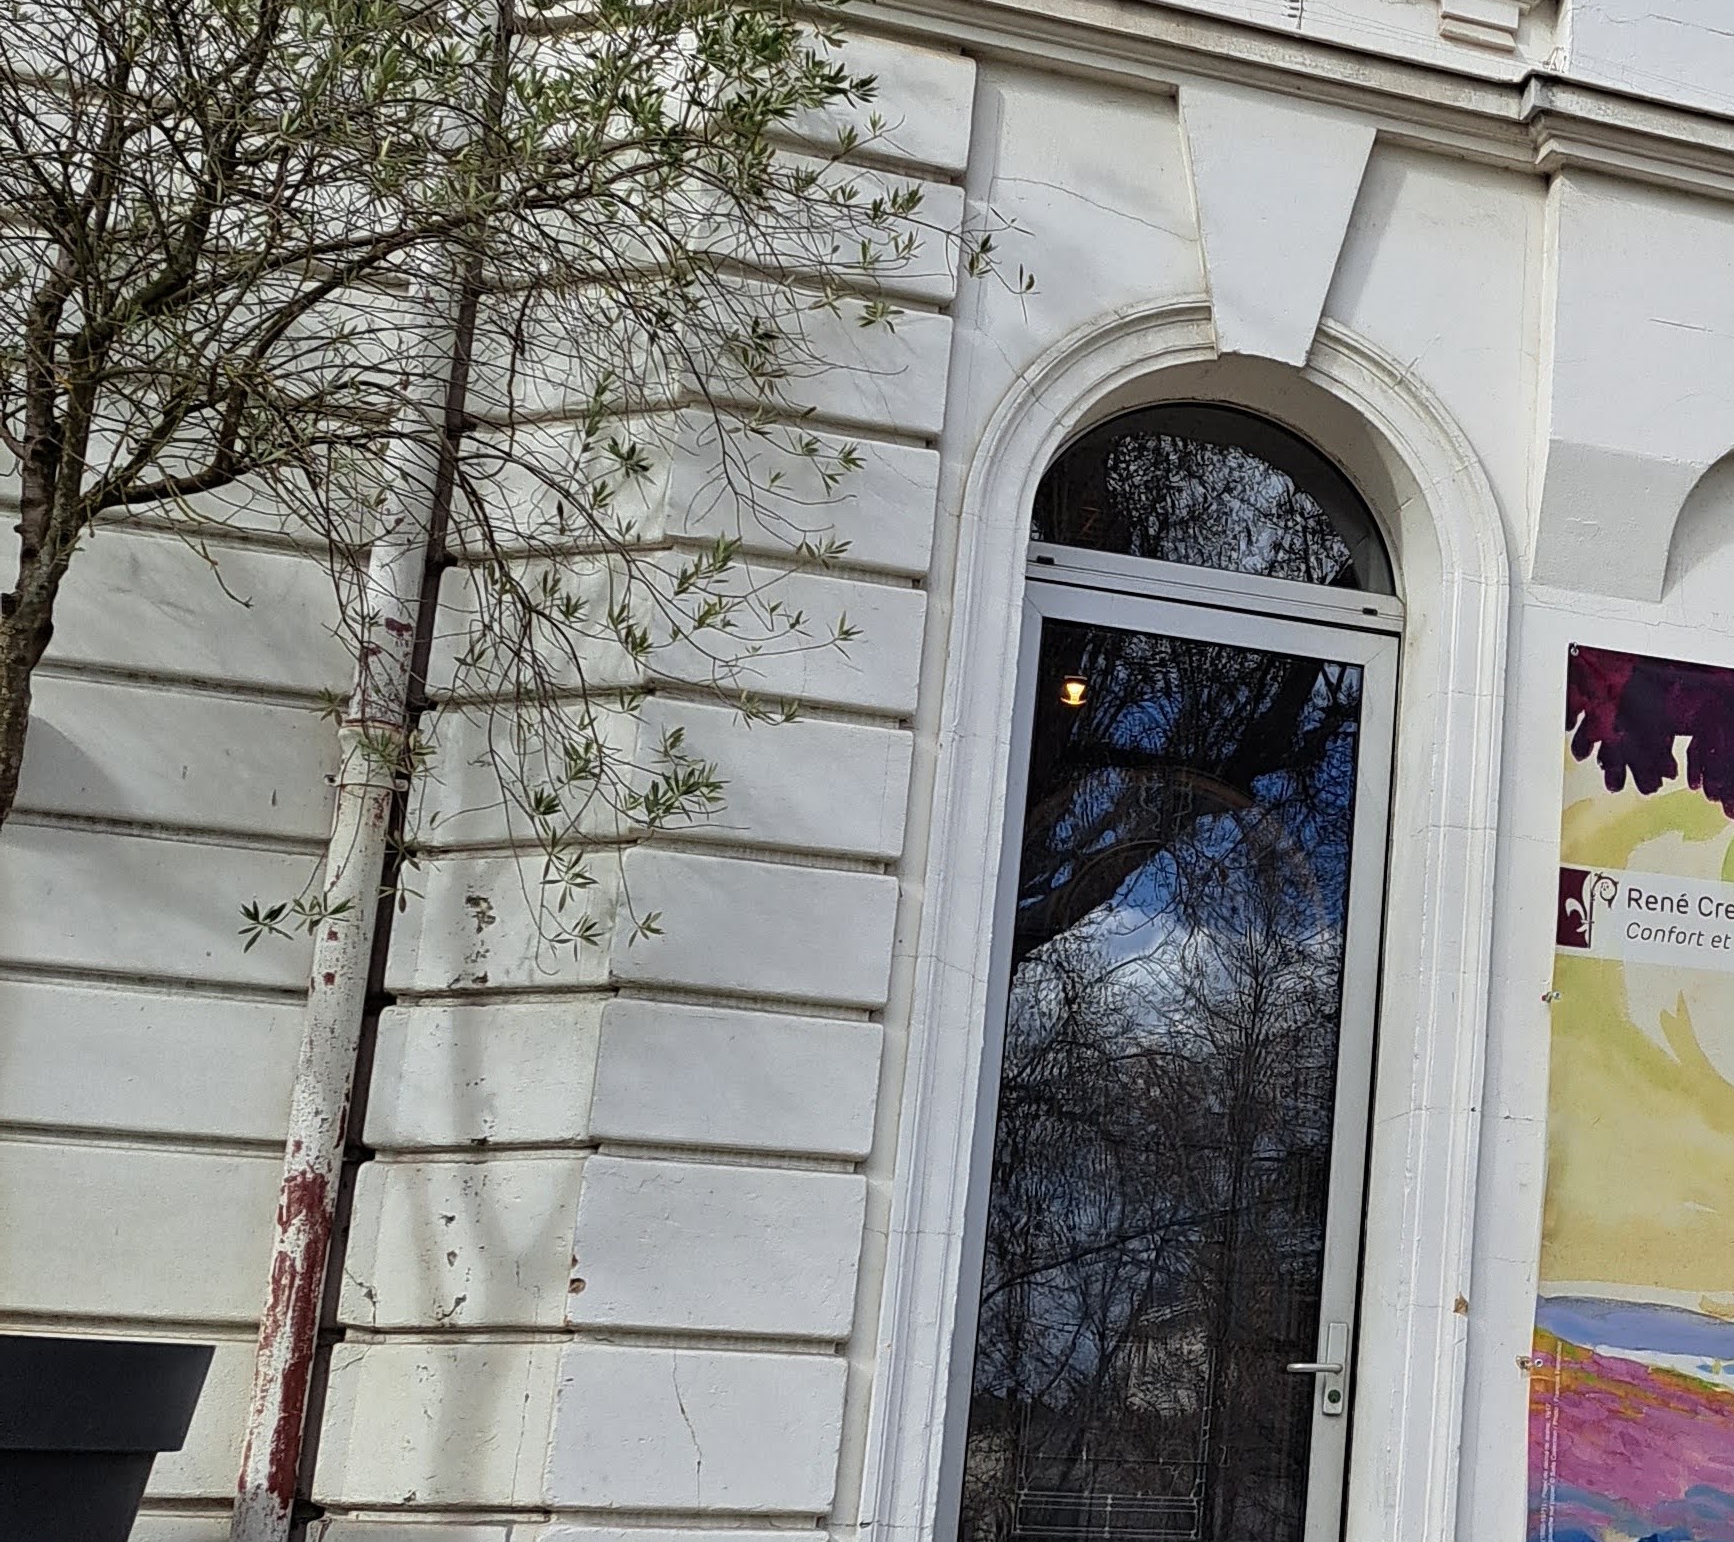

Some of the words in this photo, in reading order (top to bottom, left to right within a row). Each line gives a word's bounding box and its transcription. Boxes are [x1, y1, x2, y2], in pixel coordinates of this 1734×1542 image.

[1627, 887, 1689, 915] René
[1626, 922, 1705, 947] Confort
[1710, 933, 1731, 950] et
